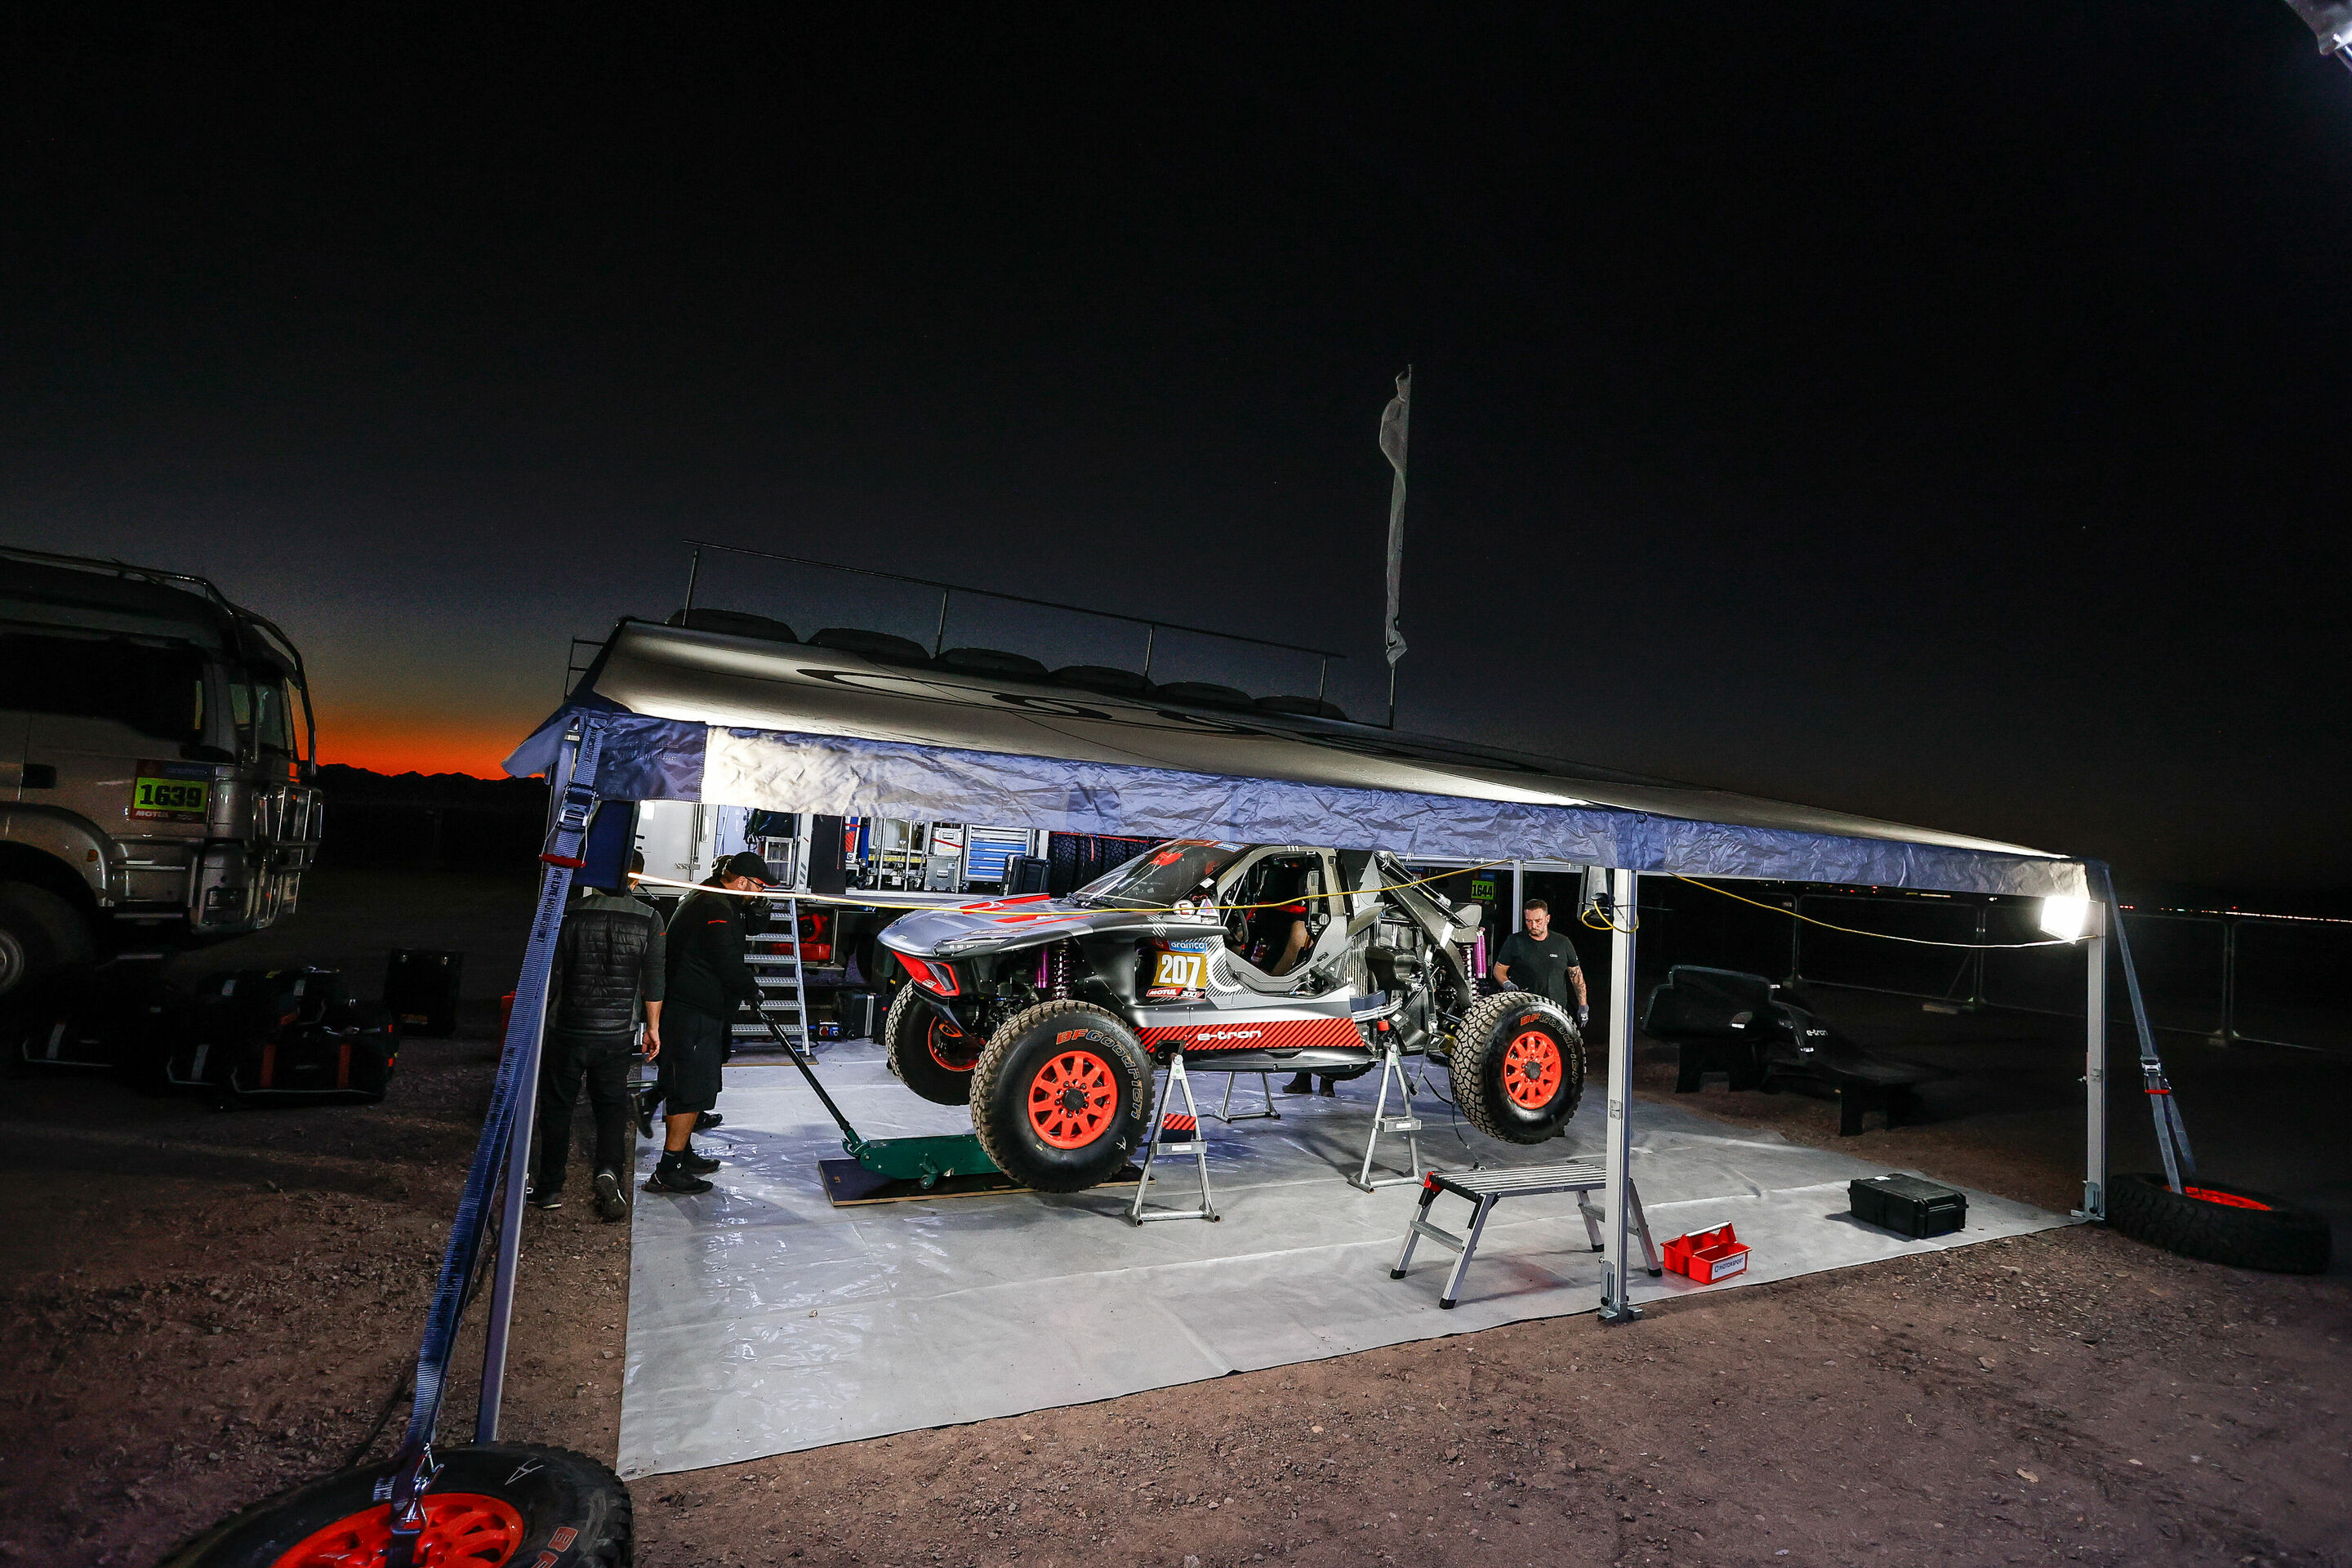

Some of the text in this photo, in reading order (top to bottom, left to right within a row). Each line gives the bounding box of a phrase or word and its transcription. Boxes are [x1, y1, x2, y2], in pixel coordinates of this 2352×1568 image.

[139, 785, 203, 808] 1639
[1472, 884, 1493, 898] 1644
[1170, 942, 1205, 950] aramco
[1158, 954, 1201, 988] 207
[1197, 1030, 1262, 1041] e-tron
[1719, 1258, 1744, 1271] MOTORSPORT
